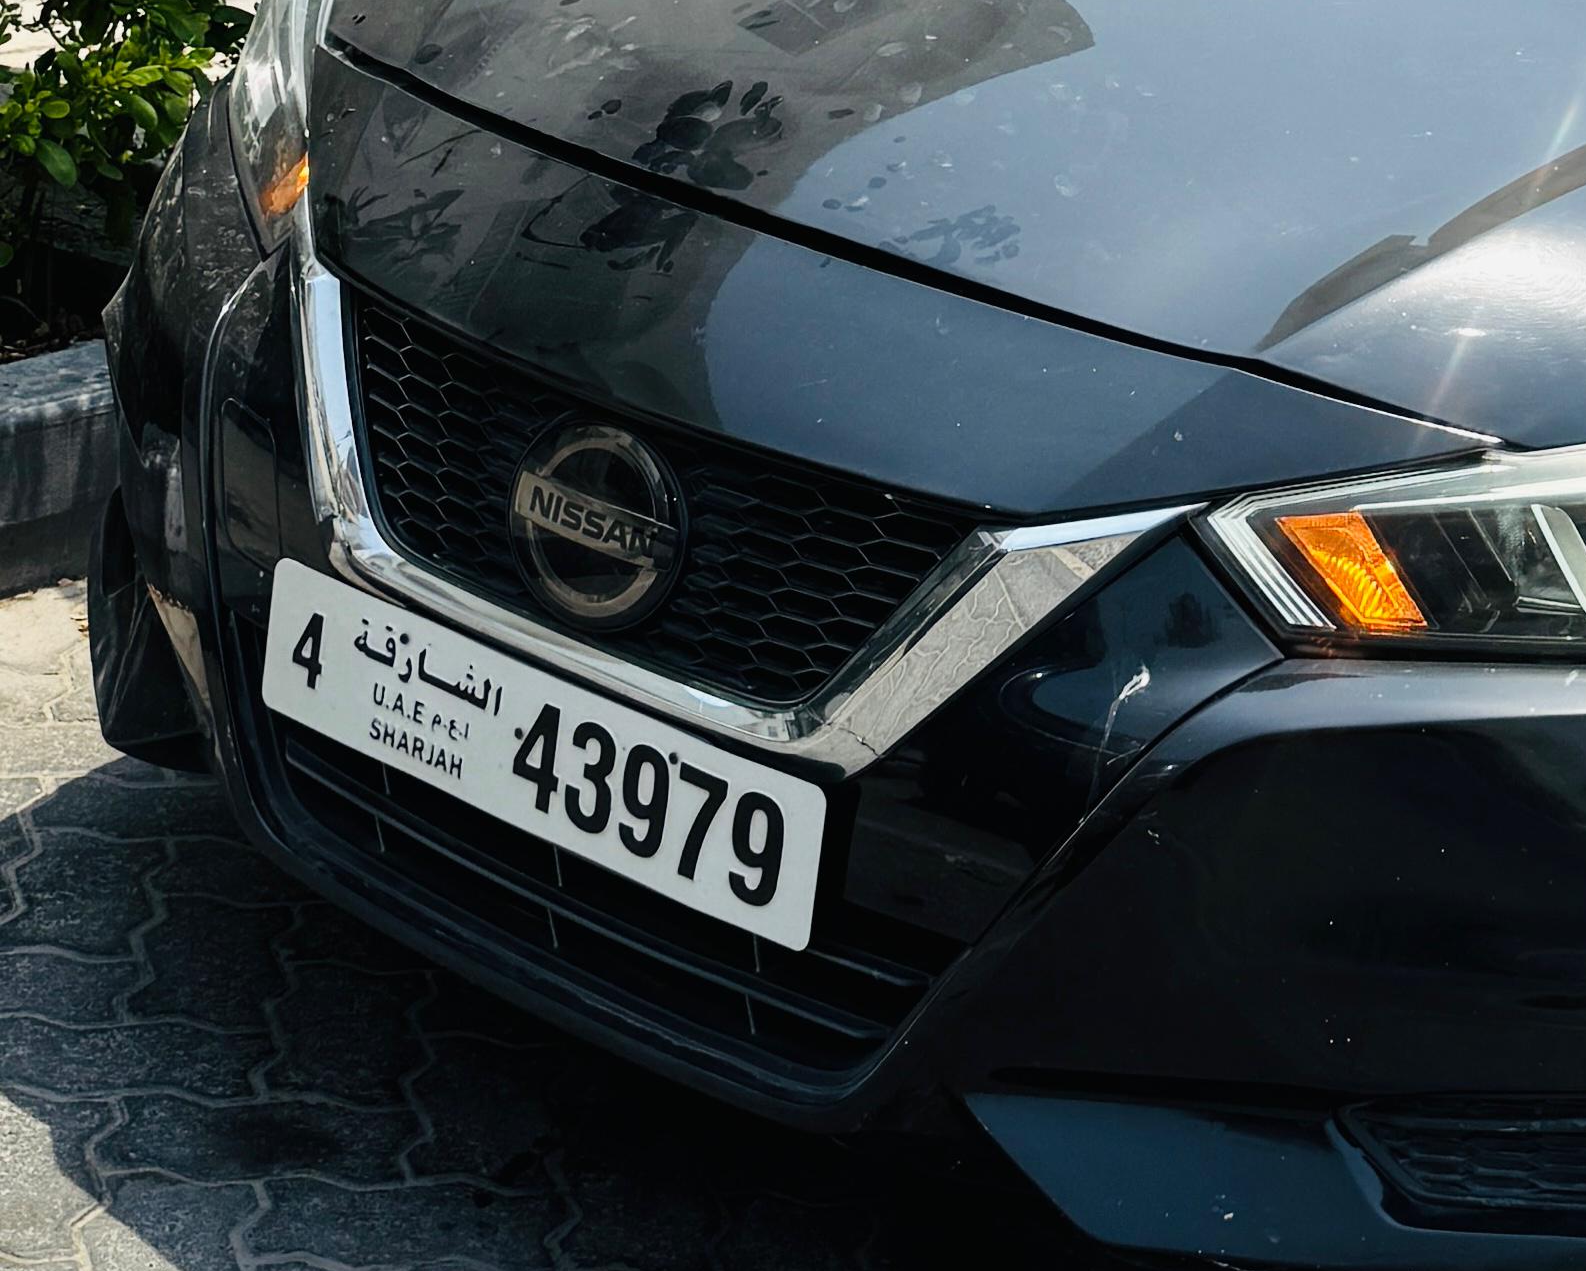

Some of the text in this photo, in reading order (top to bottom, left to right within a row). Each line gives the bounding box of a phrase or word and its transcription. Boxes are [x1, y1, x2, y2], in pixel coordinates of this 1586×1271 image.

[529, 485, 658, 560] NISSAN
[292, 612, 324, 690] 4
[354, 618, 503, 717] الشارقة
[373, 683, 425, 724] U.A.E
[369, 718, 463, 779] SHARJAH
[513, 703, 784, 907] 43979
